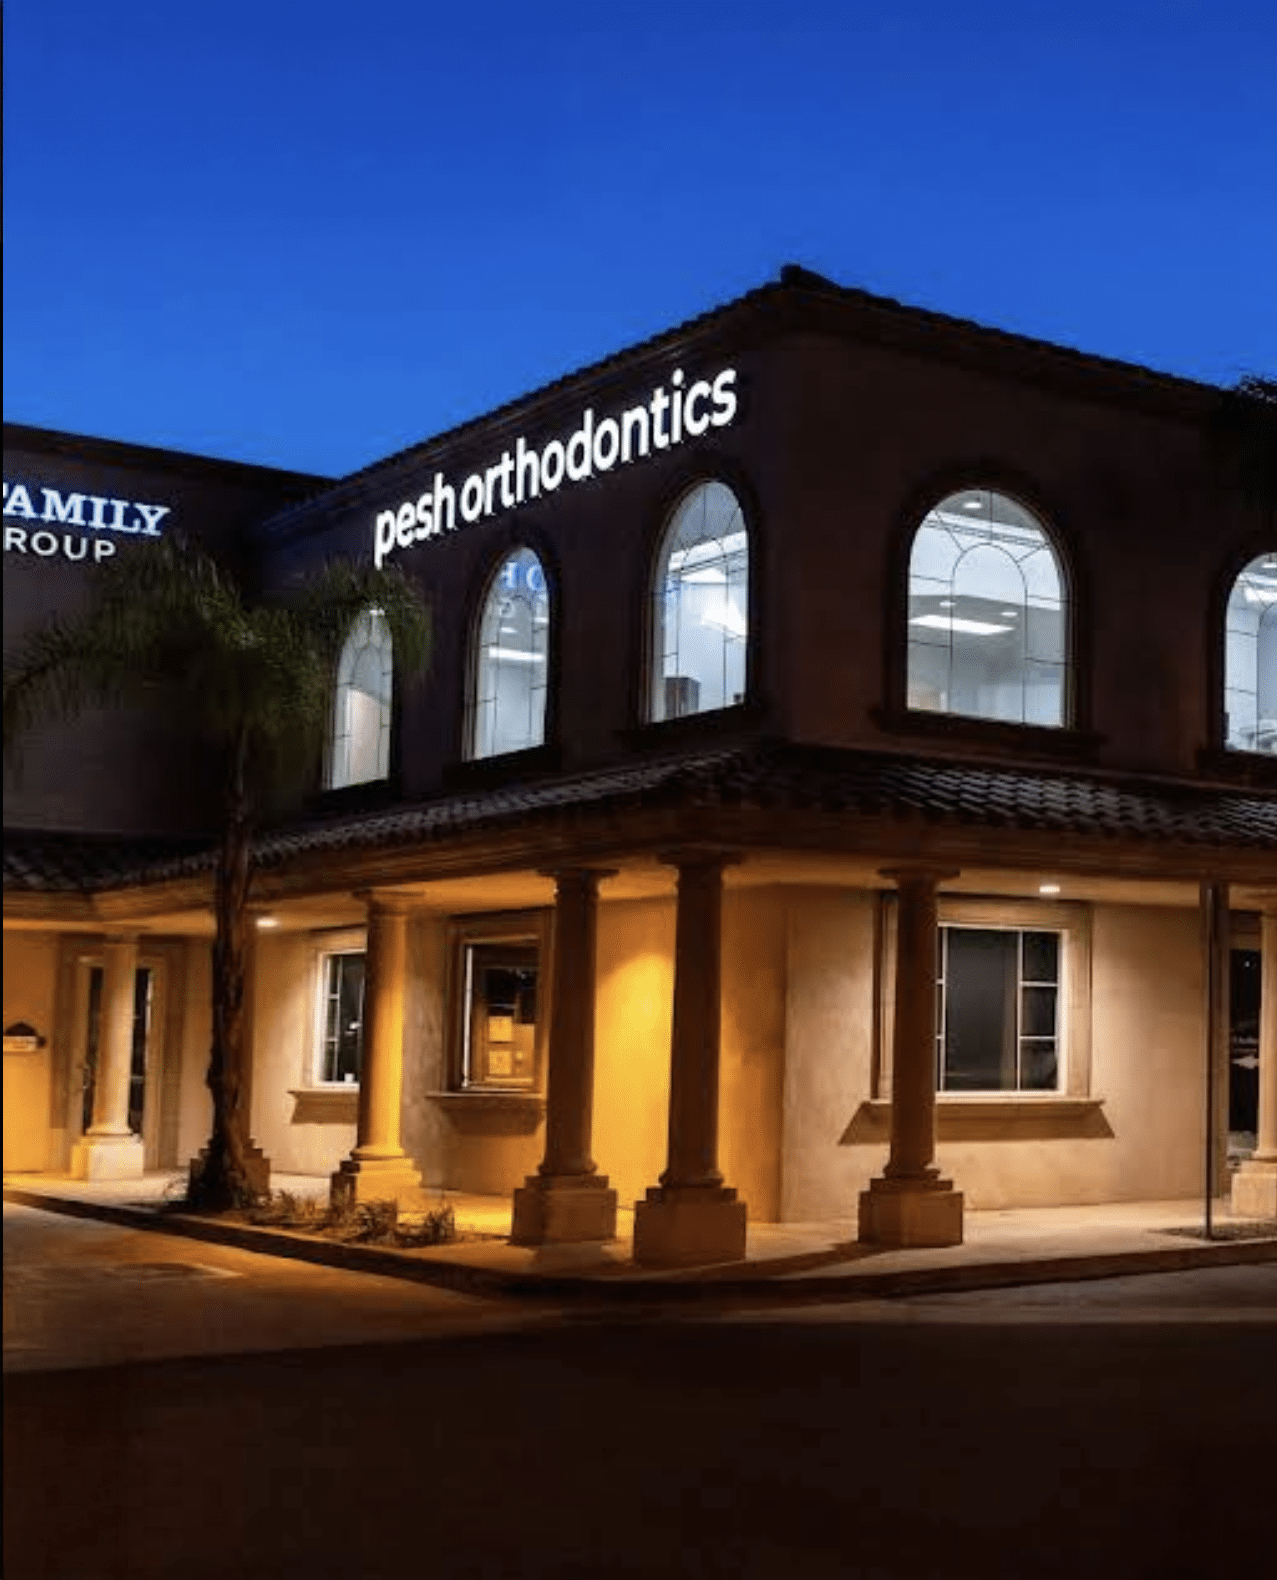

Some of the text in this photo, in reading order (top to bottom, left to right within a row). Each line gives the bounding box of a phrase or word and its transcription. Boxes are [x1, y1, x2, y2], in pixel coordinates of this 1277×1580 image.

[3, 483, 171, 536] AMILY
[374, 368, 737, 570] pesh orthodontics
